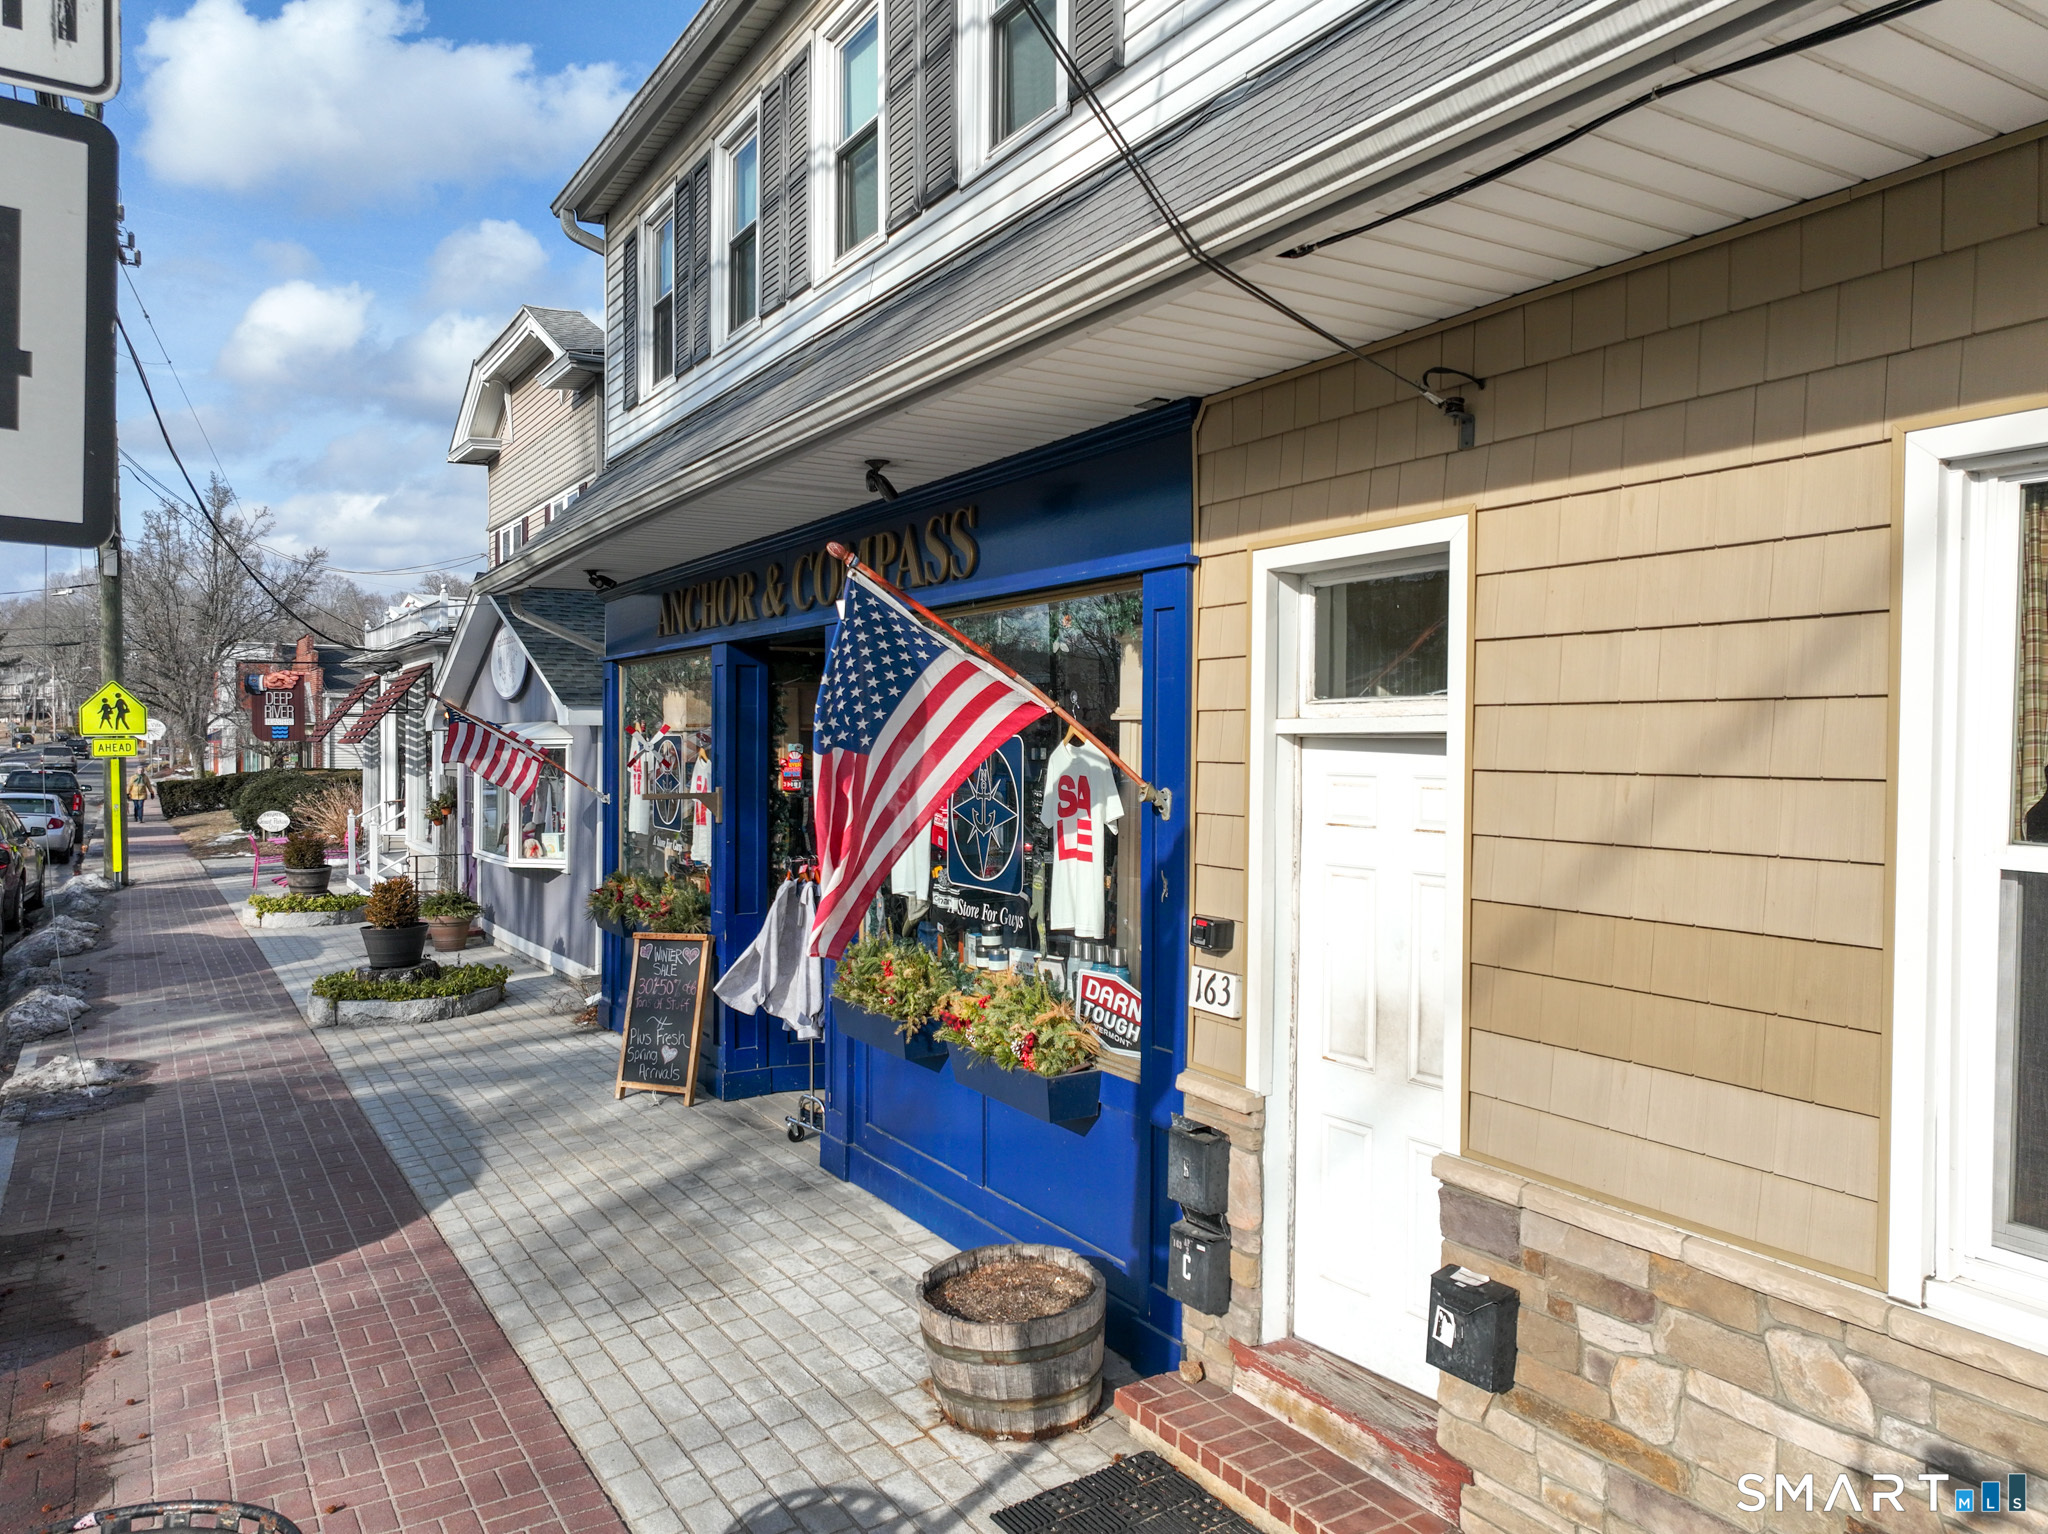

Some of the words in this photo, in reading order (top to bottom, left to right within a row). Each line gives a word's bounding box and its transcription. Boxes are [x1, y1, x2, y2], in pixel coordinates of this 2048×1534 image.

[658, 572, 757, 637] ANCHOR
[761, 563, 786, 617] &
[265, 691, 293, 705] DEEP
[264, 705, 294, 719] RIVER
[98, 743, 132, 753] AHEAD
[957, 898, 980, 920] Store
[981, 903, 998, 922] For
[1000, 907, 1024, 933] Guys
[654, 946, 683, 965] WINTER
[653, 962, 678, 977] SALE
[1194, 969, 1231, 1007] 163
[1085, 978, 1142, 1023] DARN
[1083, 1000, 1141, 1043] TOUGH
[630, 1027, 652, 1046] Plus
[656, 1027, 690, 1049] Fresh
[1093, 1024, 1132, 1047] VERMONT
[627, 1046, 658, 1066] Spring
[638, 1063, 680, 1081] Arrivals
[1182, 1253, 1192, 1281] C
